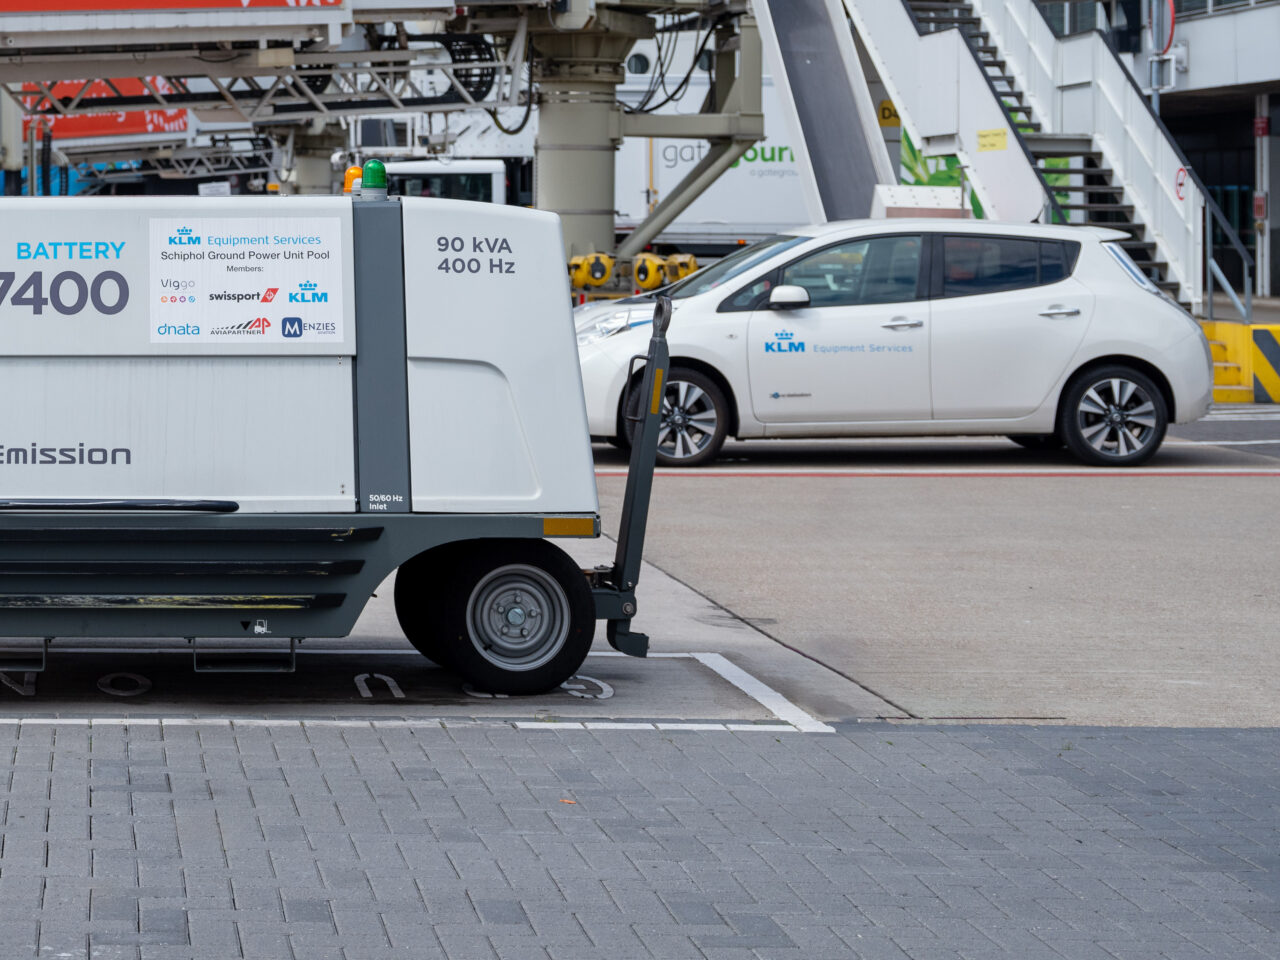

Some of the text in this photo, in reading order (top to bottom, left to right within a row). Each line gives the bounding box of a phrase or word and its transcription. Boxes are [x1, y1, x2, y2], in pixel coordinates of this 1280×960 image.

[168, 235, 321, 247] KLM Equipment Services
[437, 236, 513, 253] 90 kVA
[16, 241, 126, 260] BATTERY
[161, 250, 330, 262] Schiphol Ground Power Unit Pool
[226, 265, 264, 273] Members:
[437, 258, 516, 274] 400 Hz
[160, 278, 196, 290] Viggo
[209, 291, 261, 303] swissport
[288, 292, 328, 303] KLM
[157, 323, 200, 336] dnata
[283, 320, 336, 336] MENZIES
[764, 341, 913, 354] KLM Equipment Services
[369, 494, 403, 502] 50/60 Hz
[369, 502, 387, 510] Inlet
